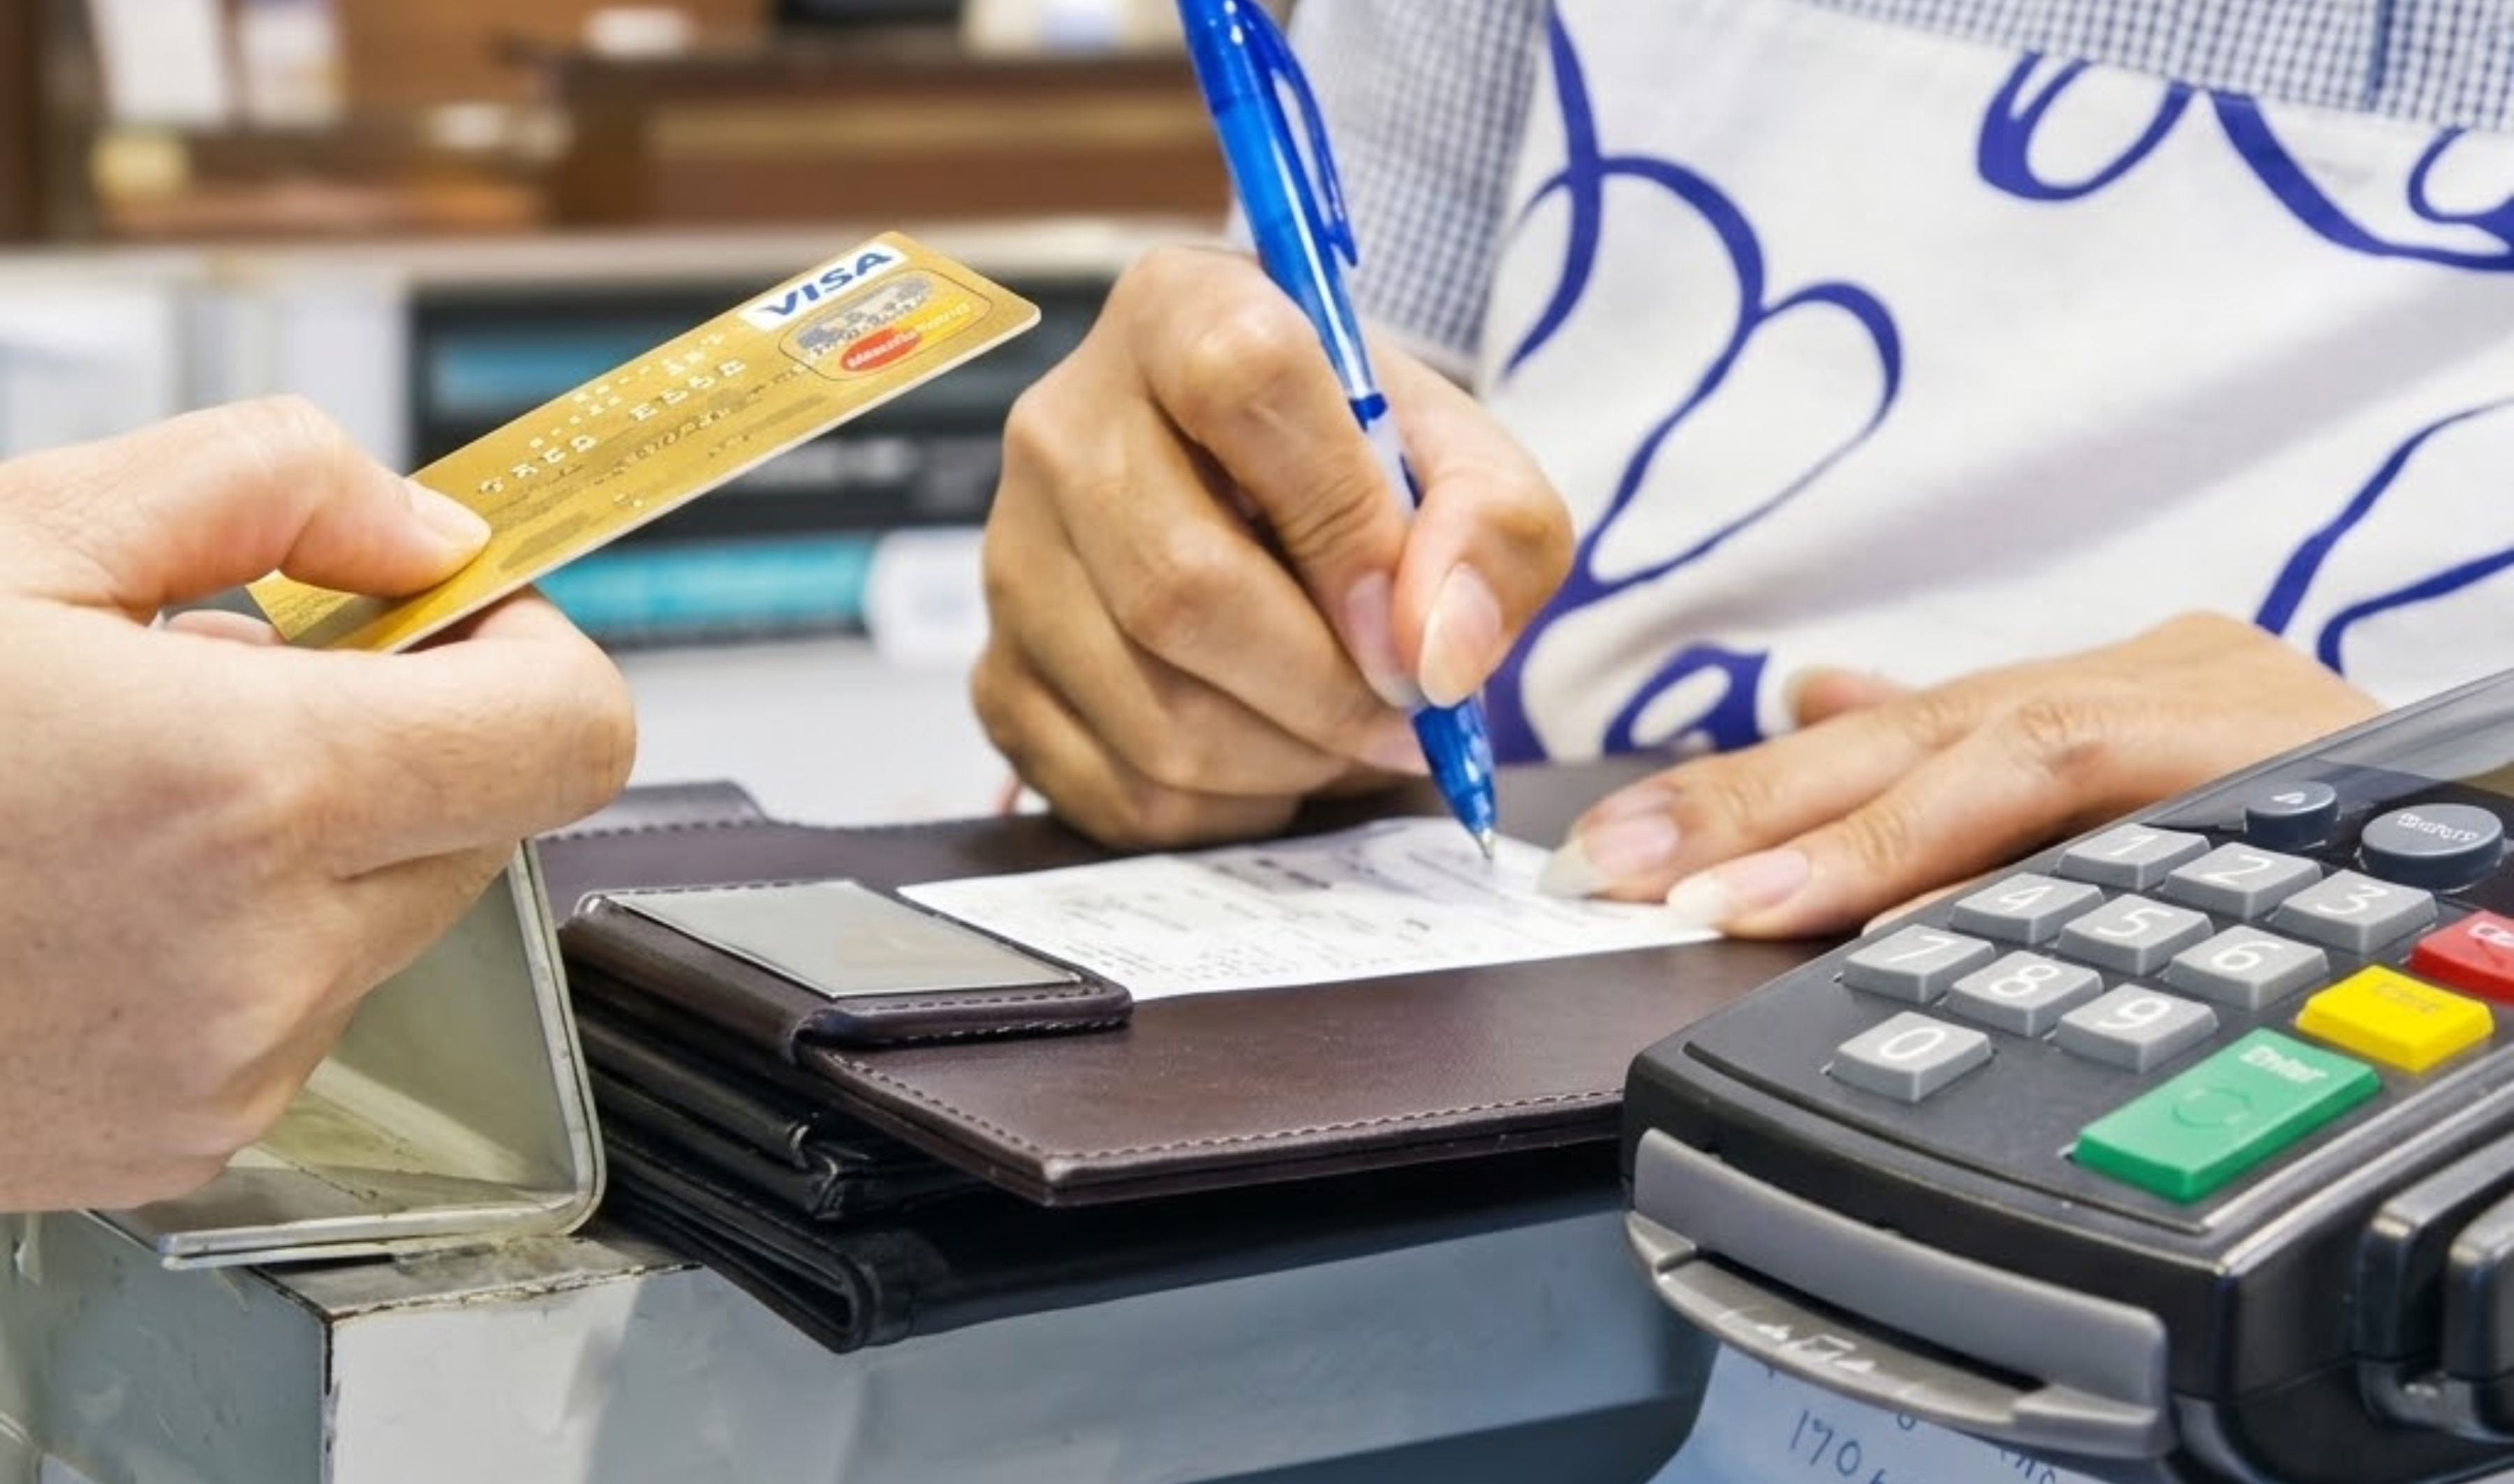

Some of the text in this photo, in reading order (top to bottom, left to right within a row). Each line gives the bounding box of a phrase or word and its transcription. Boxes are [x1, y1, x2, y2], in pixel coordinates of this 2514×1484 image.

[760, 253, 893, 316] VISA
[2108, 834, 2161, 857] 1
[2201, 854, 2273, 885] 2
[1999, 885, 2055, 912] 4
[2316, 884, 2388, 916] 3
[2096, 909, 2174, 938] 5
[1888, 935, 1957, 964] 7
[2210, 940, 2283, 972] 6
[1989, 965, 2061, 998] 8
[2096, 997, 2170, 1030] 9
[1880, 1027, 1946, 1060] 0
